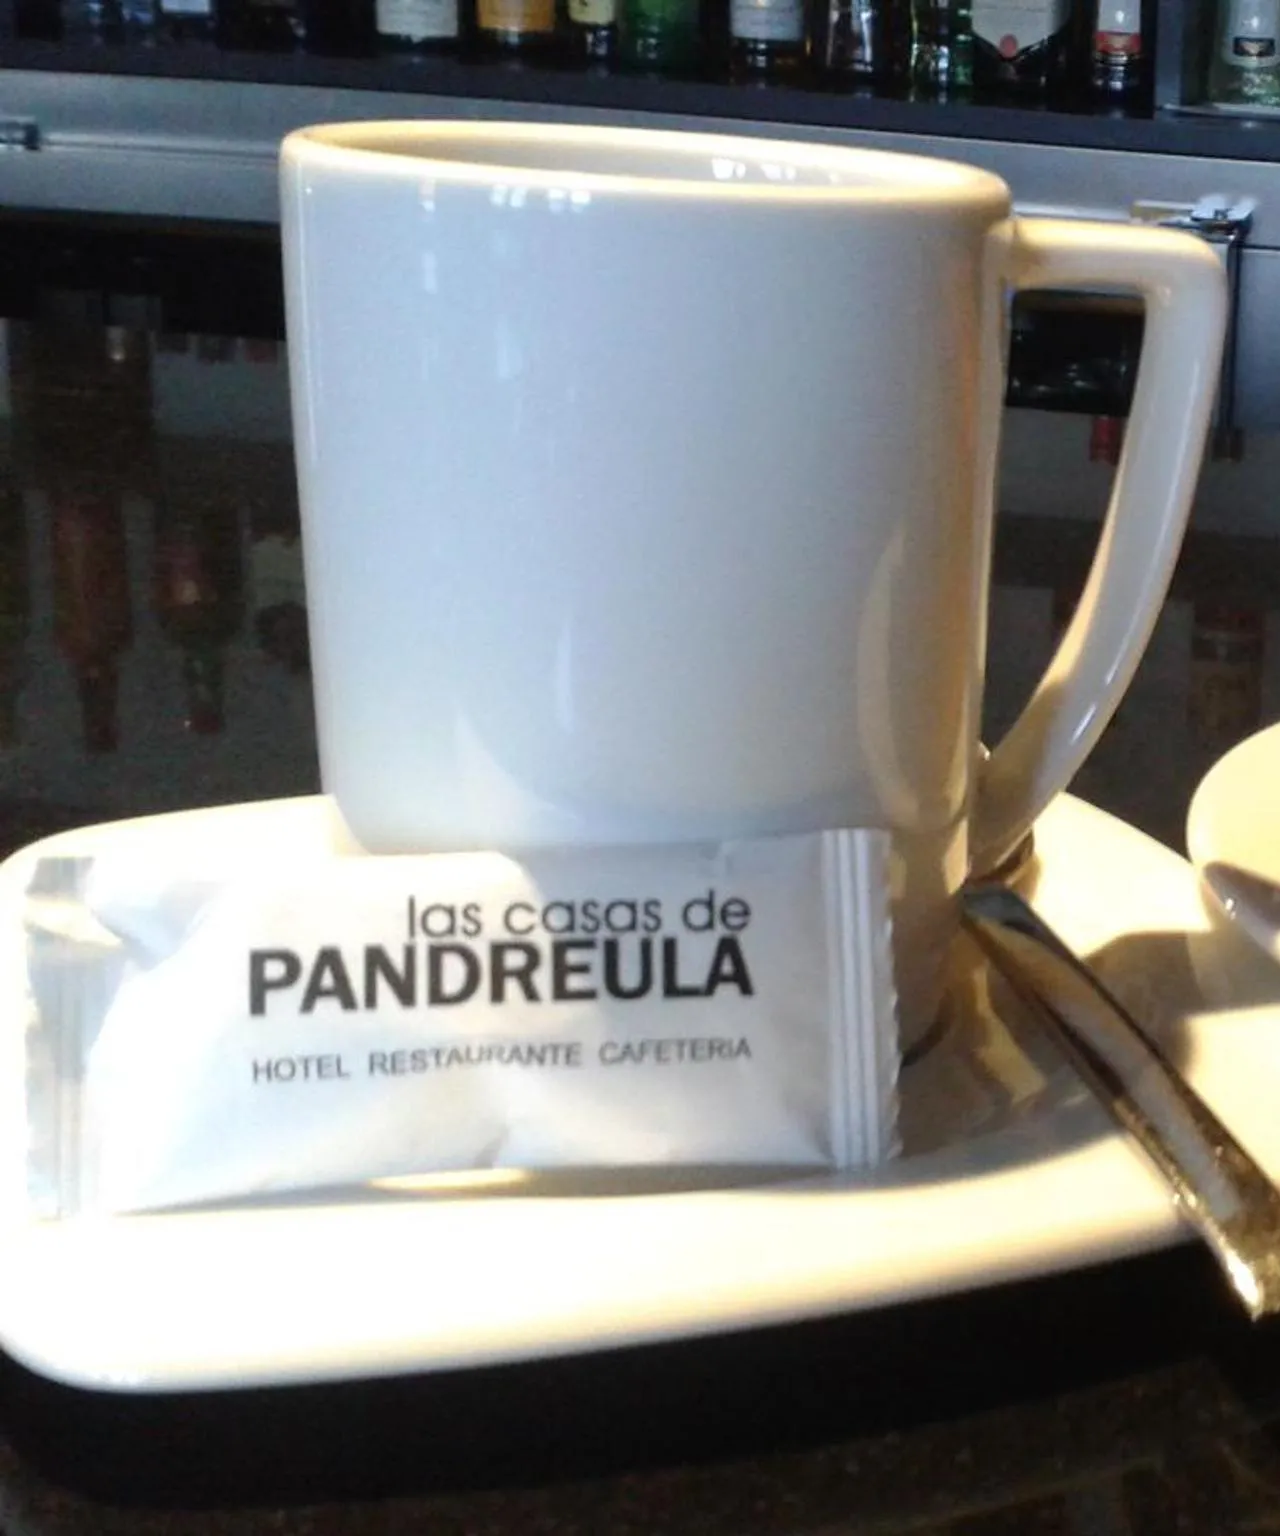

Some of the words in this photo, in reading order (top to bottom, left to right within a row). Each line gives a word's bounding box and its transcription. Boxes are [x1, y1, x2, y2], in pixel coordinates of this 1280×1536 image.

[407, 895, 483, 940] las
[503, 898, 663, 937] casas
[682, 888, 752, 934] de
[248, 935, 755, 1018] PANDREULA
[252, 1054, 350, 1083] HOTEL
[368, 1042, 583, 1077] RESTAURANTE
[599, 1037, 752, 1065] CAFETERIA
